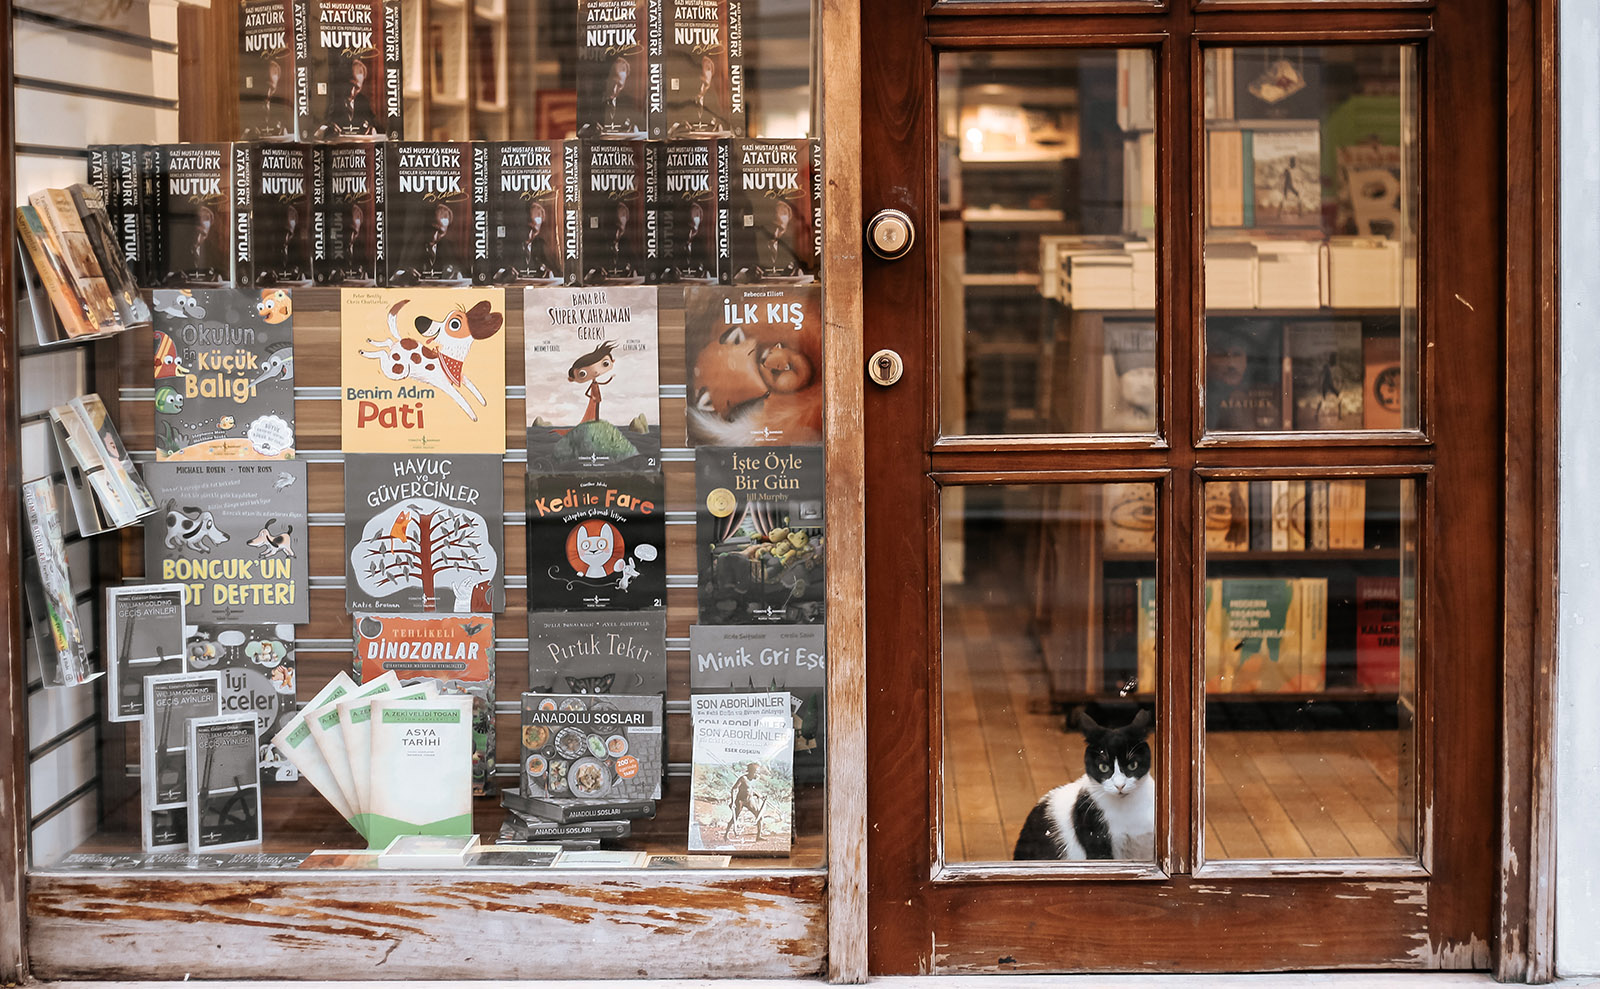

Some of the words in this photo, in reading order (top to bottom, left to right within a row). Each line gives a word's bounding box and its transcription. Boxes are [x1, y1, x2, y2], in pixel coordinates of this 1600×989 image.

[246, 10, 284, 27] ATATÜRK
[320, 10, 372, 24] ATATÜRK
[587, 7, 636, 22] ATATÜRK
[675, 6, 718, 20] ATATÜRK
[294, 4, 304, 60] ATATÜRK
[385, 6, 394, 62] ATATÜRK
[587, 29, 637, 47] NUTUK
[650, 2, 658, 56] ATATÜRK
[675, 28, 719, 45] NUTUK
[730, 3, 738, 57] ATATÜRK
[246, 32, 286, 52] NUTUK
[320, 31, 372, 48] NUTUK
[297, 67, 307, 116] NUTUK
[386, 68, 398, 118] NUTUK
[650, 63, 660, 114] NUTUK
[732, 65, 741, 114] NUTUK
[170, 156, 220, 170] ATATÜRK
[262, 156, 303, 169] ATATÜRK
[332, 155, 366, 169] ATATÜRK
[399, 154, 460, 168] ATATÜRK
[501, 152, 551, 166] ATATÜRK
[591, 153, 634, 166] ATATÜRK
[667, 153, 708, 166] ATATÜRK
[743, 152, 797, 164] ATATÜRK
[121, 152, 132, 206] ATATÜRK
[237, 150, 245, 206] ATATÜRK
[313, 150, 321, 205] ATATÜRK
[332, 177, 367, 193] NUTUK
[400, 176, 461, 192] NUTUK
[474, 148, 483, 203] ATATÜRK
[501, 175, 552, 191] NUTUK
[565, 147, 573, 203] ATATÜRK
[591, 175, 635, 191] NUTUK
[646, 149, 654, 203] ATATÜRK
[667, 175, 709, 191] NUTUK
[743, 173, 798, 190] NUTUK
[170, 179, 221, 195] NUTUK
[262, 178, 304, 194] NUTUK
[124, 214, 136, 262] NUTUK
[238, 213, 248, 262] NUTUK
[314, 212, 324, 260] NUTUK
[475, 211, 486, 259] NUTUK
[566, 210, 575, 260] NUTUK
[647, 210, 656, 259] NUTUK
[572, 293, 592, 306] BANA
[594, 292, 607, 304] BİR
[548, 308, 577, 325] SÜPER
[580, 308, 631, 324] KAHRAMAN
[724, 298, 758, 324] İLK
[767, 302, 804, 330] KIŞ
[182, 324, 255, 345] Okulun
[184, 348, 196, 360] En
[198, 349, 258, 374] Küçük
[185, 372, 256, 404] Balığı
[347, 386, 392, 400] Benim
[397, 386, 435, 399] Adım
[358, 401, 424, 428] Pati
[176, 466, 203, 474] MICHAEL
[393, 458, 452, 479] HAVUÇ
[732, 452, 760, 474] İşte
[765, 452, 802, 474] Öyle
[736, 475, 759, 490] Bir
[764, 474, 800, 490] Gün
[367, 481, 479, 507] GÜVERCİNLER
[535, 488, 579, 517] Kedi
[582, 493, 599, 505] ile
[605, 489, 654, 514] Fare
[746, 493, 756, 501] Jill
[759, 493, 789, 502] Murphy
[214, 580, 295, 605] DEFTERİ
[393, 627, 455, 638] TEHLİKELİ
[368, 638, 479, 659] DİNOZORLAR
[547, 634, 601, 664] Pırtık
[607, 633, 652, 663] Tekir
[697, 647, 754, 672] Minik
[760, 648, 790, 666] Gri
[226, 670, 246, 692] İyi
[697, 700, 717, 709] SON
[720, 697, 784, 709] ABORİJİNLER
[532, 713, 590, 724] ANADOLU
[594, 714, 645, 724] SOSLARI
[402, 737, 440, 746] TARİHİ
[699, 728, 720, 737] SON
